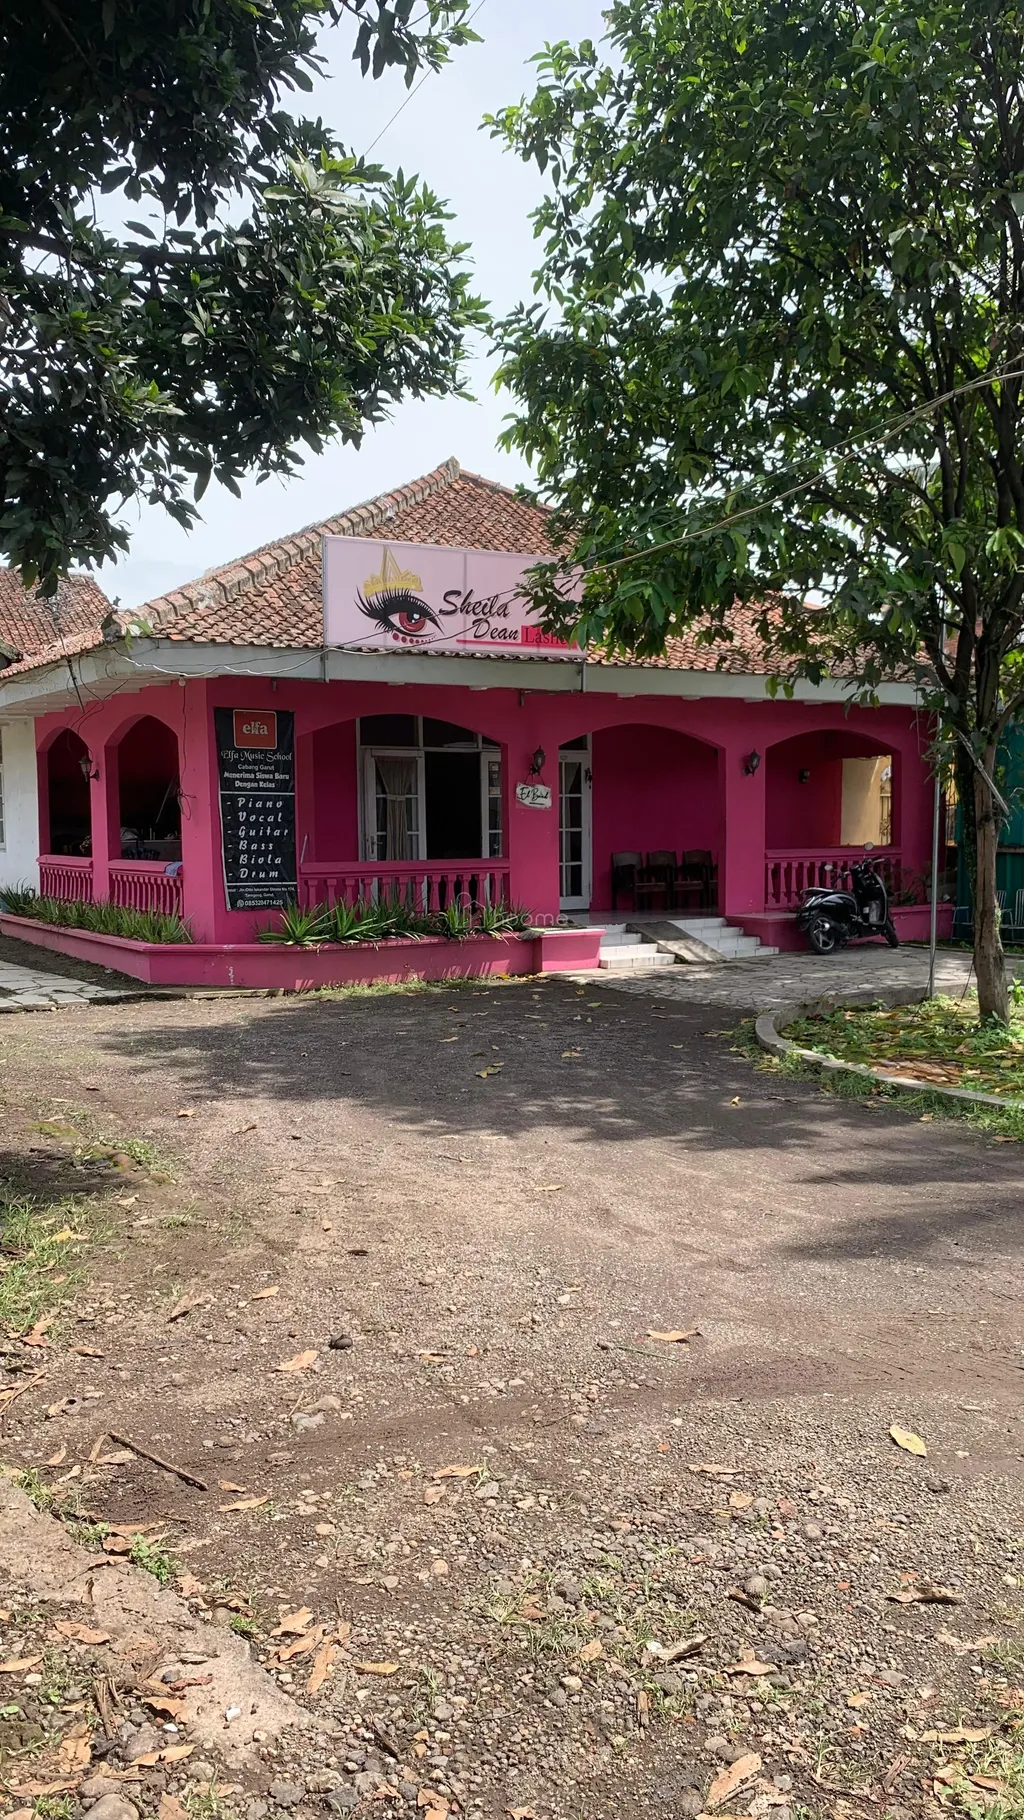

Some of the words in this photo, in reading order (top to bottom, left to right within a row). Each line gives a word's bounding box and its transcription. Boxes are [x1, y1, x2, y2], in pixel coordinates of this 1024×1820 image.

[438, 588, 511, 618] Sheila
[471, 617, 519, 641] Dean
[524, 627, 572, 645] Lash
[242, 721, 269, 735] elfa
[220, 750, 239, 762] Elfa
[240, 750, 265, 762] Music
[265, 751, 293, 763] School
[237, 763, 259, 771] Cabang
[223, 771, 255, 779] Menerima
[255, 772, 273, 780] Siswa
[274, 772, 290, 780] Baru
[234, 780, 258, 789] Dengan
[237, 797, 283, 808] Piano
[237, 811, 283, 822] Vocal
[238, 825, 289, 839] Guitar
[238, 839, 274, 851] Bass
[239, 854, 282, 864] Biola
[239, 868, 279, 879] Drum
